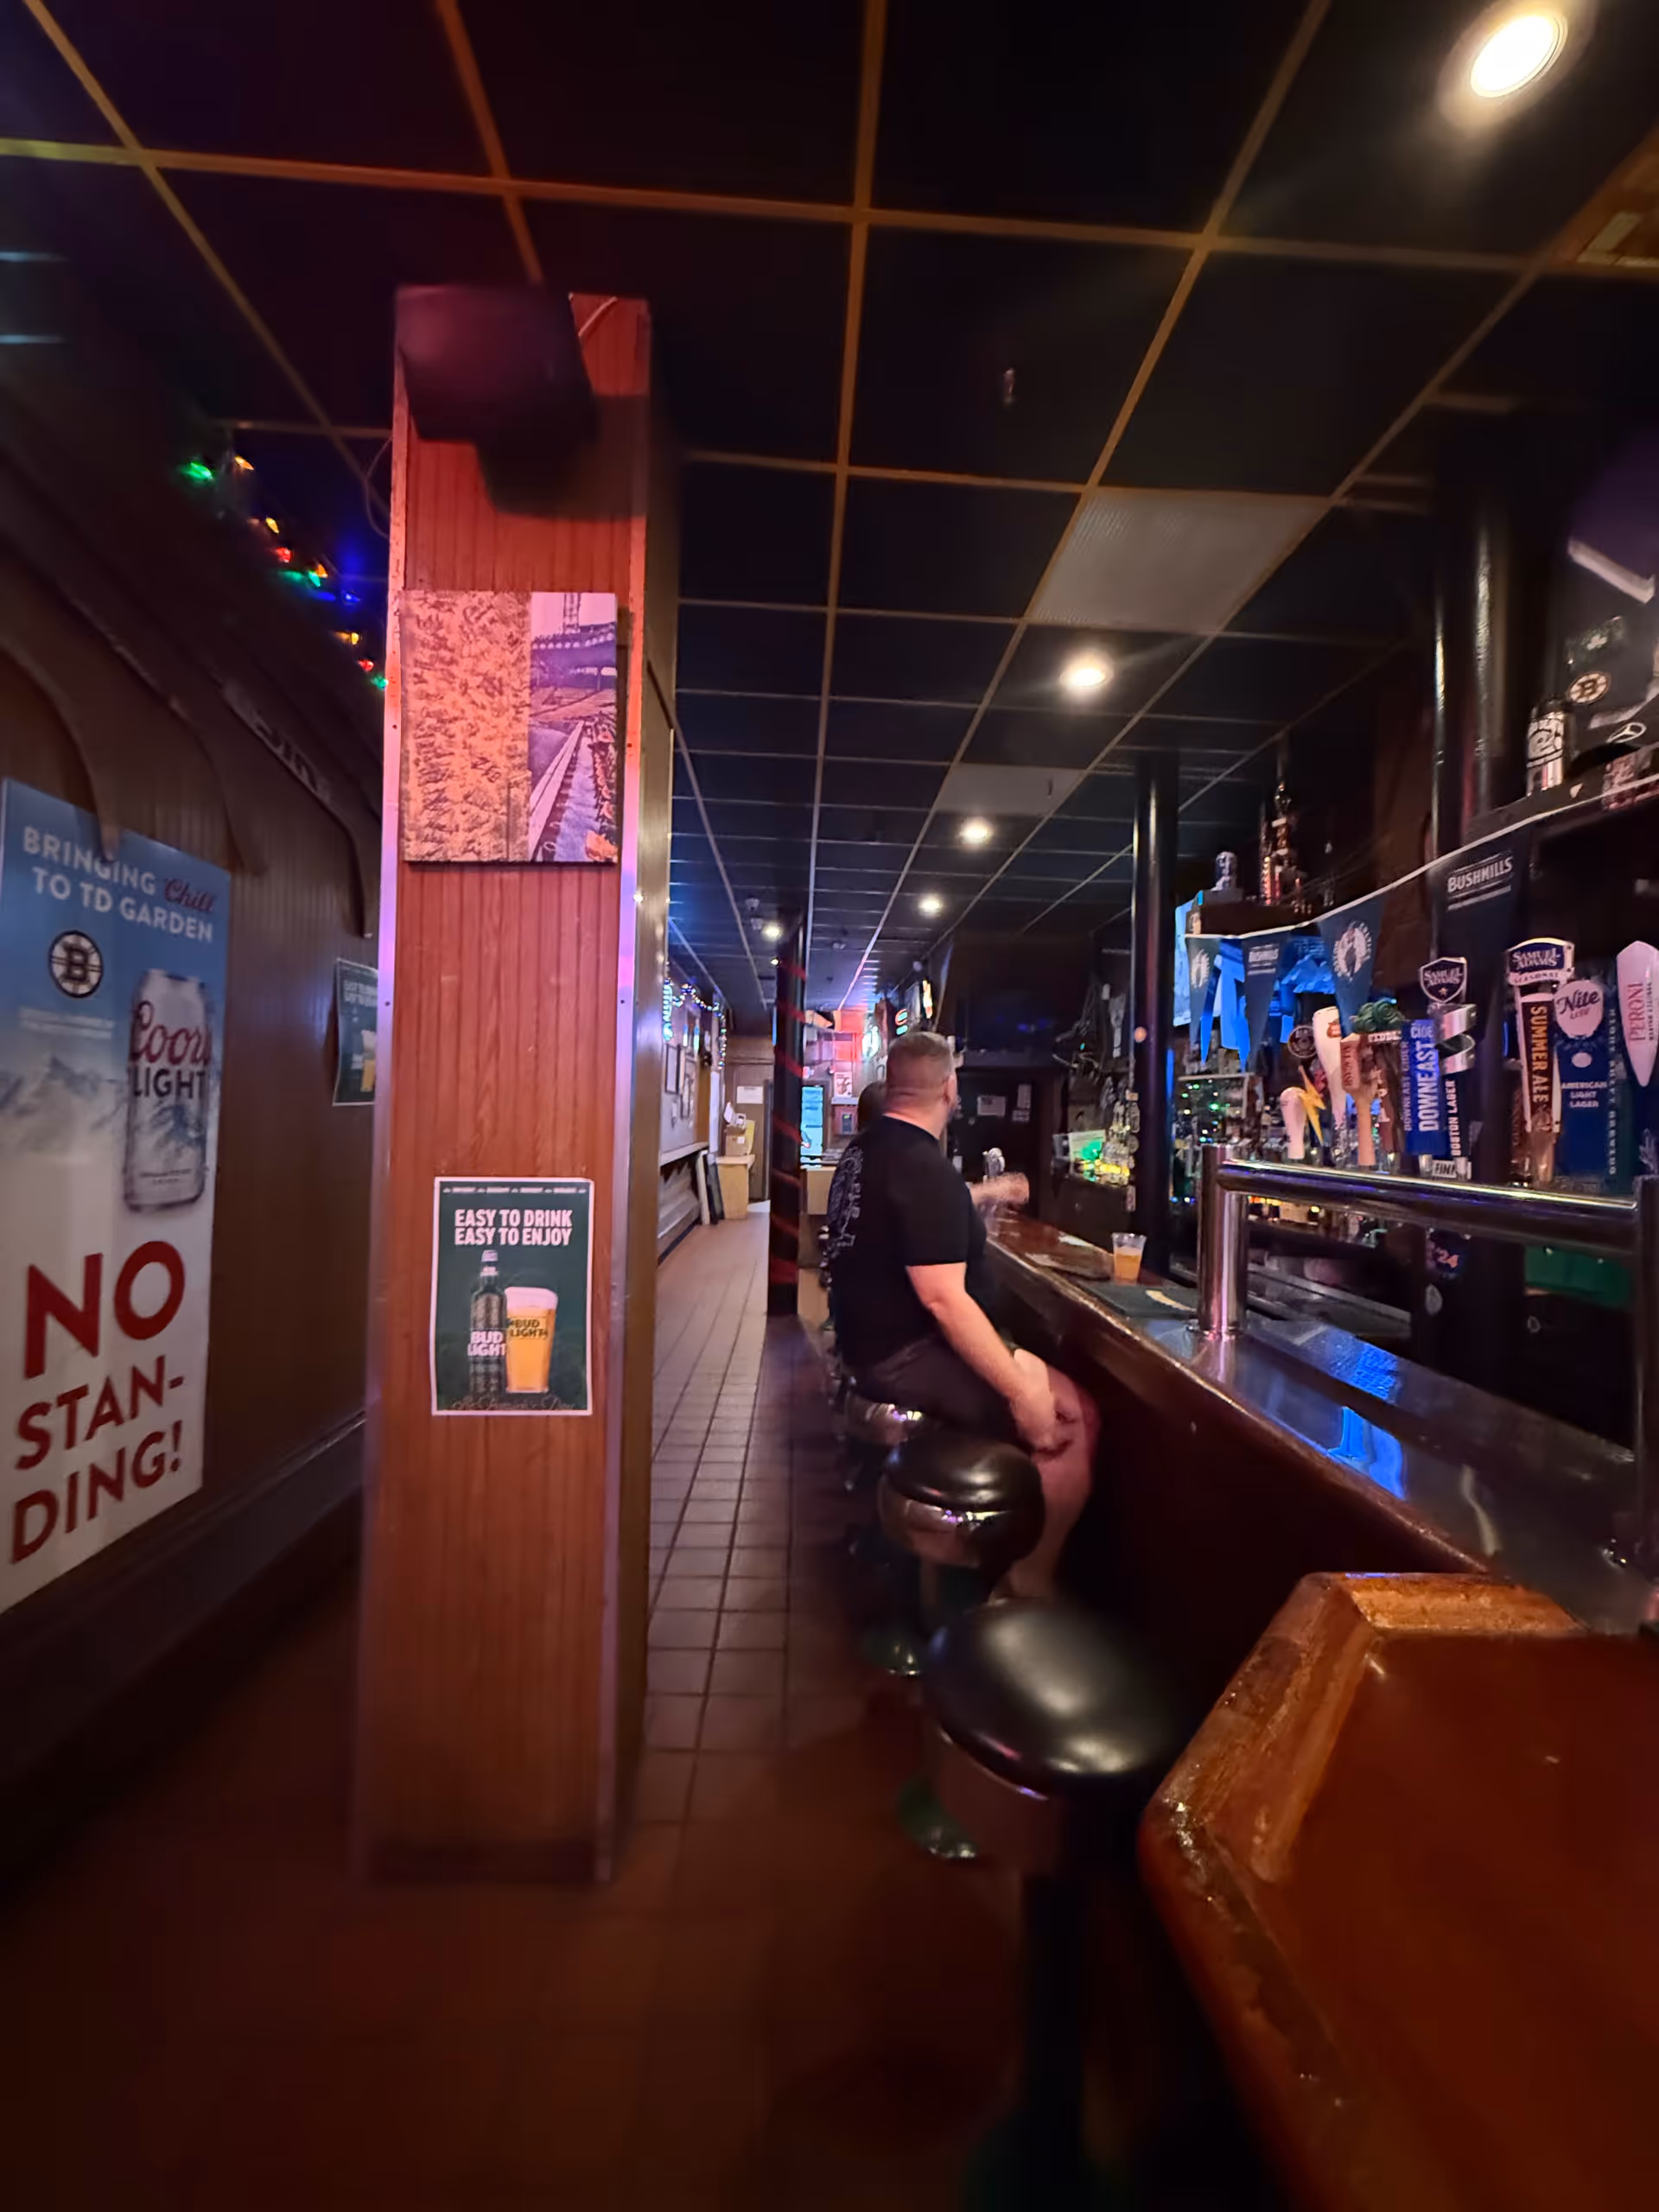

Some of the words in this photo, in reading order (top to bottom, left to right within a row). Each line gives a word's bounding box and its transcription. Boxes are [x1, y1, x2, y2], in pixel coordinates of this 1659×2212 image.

[23, 825, 156, 896] BRINGING
[163, 877, 216, 914] Chill
[1447, 855, 1513, 893] BUSHMILLS
[32, 867, 72, 900] TO
[79, 881, 113, 913] TD
[120, 896, 214, 944] GARDEN
[1556, 989, 1601, 1014] Nite
[1626, 982, 1646, 1041] PERONI
[1530, 1006, 1548, 1071] SUMMER
[133, 1067, 208, 1100] LIGHT
[1415, 1040, 1440, 1132] DOWNEAST
[1446, 1080, 1459, 1114] LAGER
[1532, 1072, 1549, 1103] ALE
[1561, 1081, 1607, 1090] AMERICAN
[1448, 1116, 1462, 1156] BOSTON
[454, 1209, 497, 1227] EASY
[499, 1209, 520, 1227] TO
[524, 1210, 573, 1227] DRINK
[454, 1227, 496, 1245] EASY
[499, 1227, 519, 1245] TO
[522, 1227, 572, 1245] ENJOY
[24, 1241, 186, 1379] NO
[467, 1343, 506, 1356] LIGHT
[470, 1331, 504, 1344] BUD
[16, 1355, 185, 1470] STAN-
[11, 1420, 182, 1565] DING!
